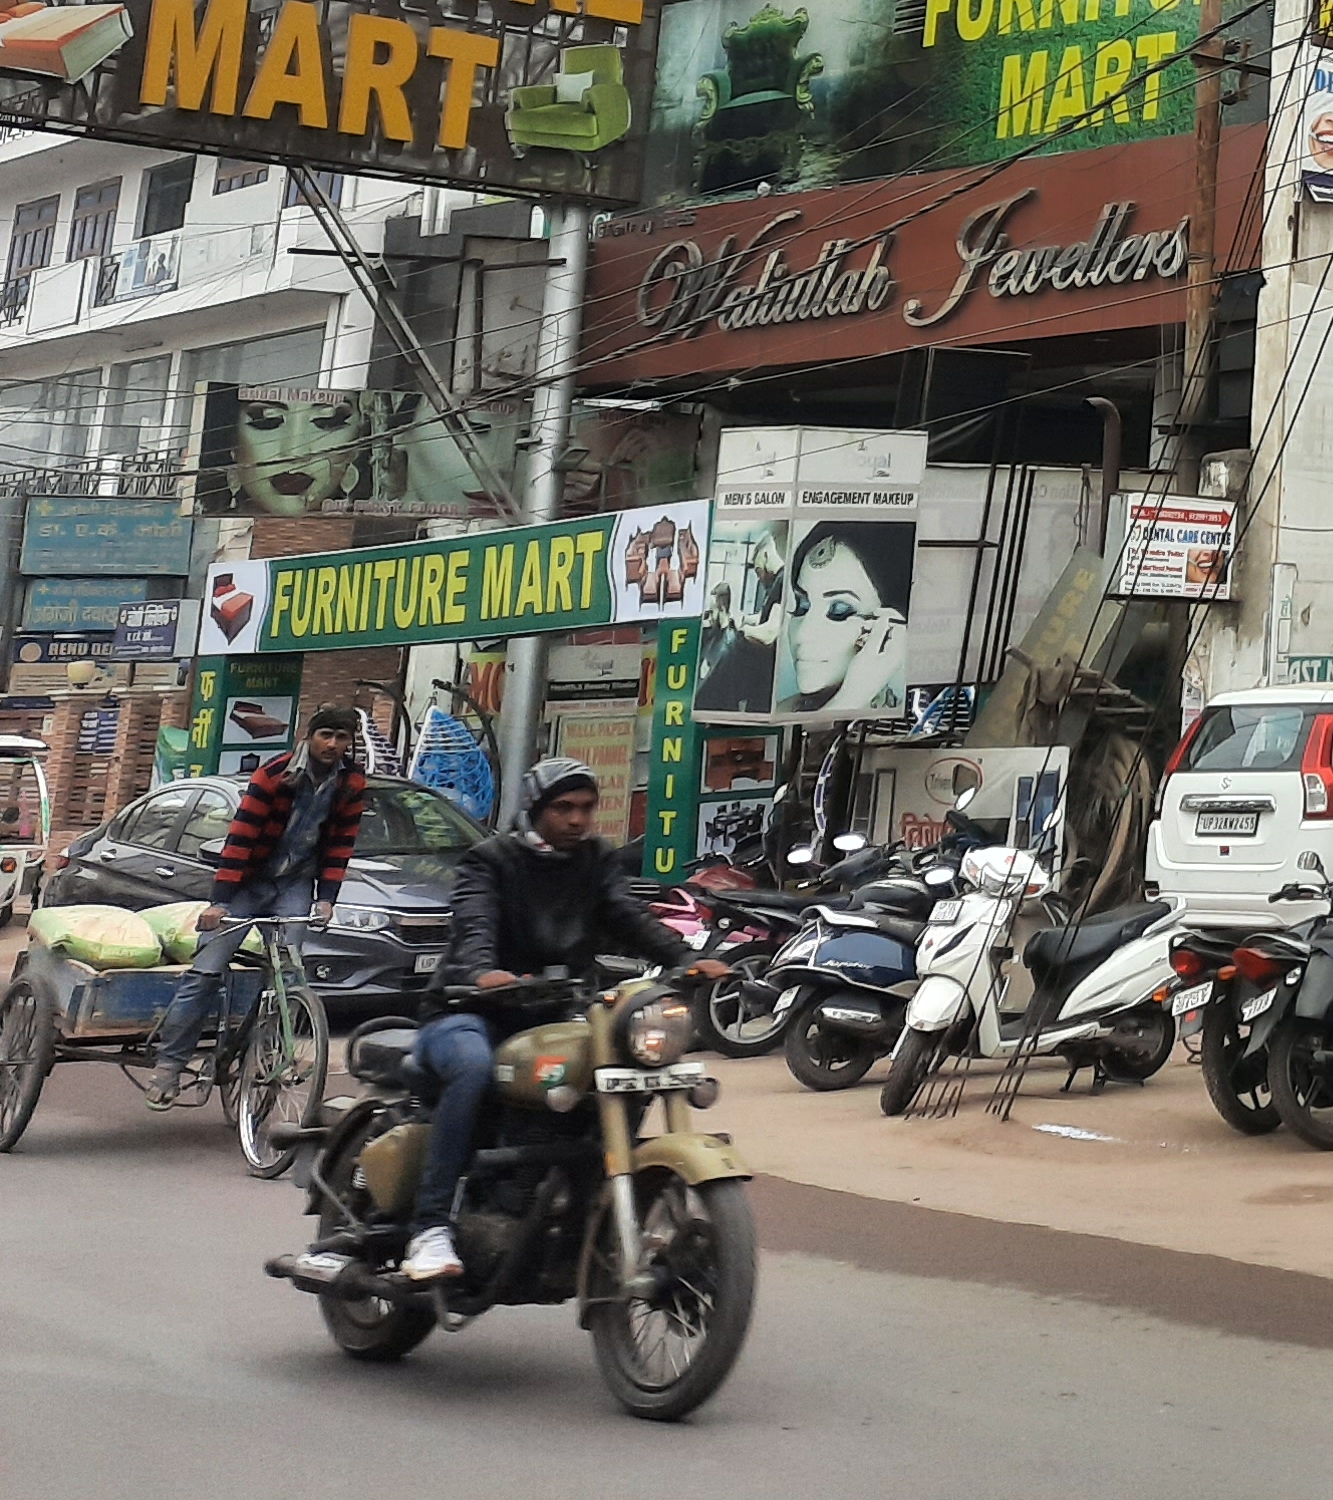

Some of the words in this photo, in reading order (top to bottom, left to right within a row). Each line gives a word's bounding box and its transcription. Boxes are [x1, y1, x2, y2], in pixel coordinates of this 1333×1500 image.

[996, 31, 1177, 139] MART
[904, 188, 1189, 329] Jewellers
[754, 491, 785, 505] SALON
[802, 491, 871, 505] ENGAGEMENT
[873, 492, 914, 506] MAKEUP
[1143, 527, 1175, 542] DENTAL
[1177, 529, 1198, 543] CARE
[1201, 531, 1231, 545] CENTRE
[270, 550, 470, 638] FURNITURE
[481, 531, 604, 620] MART
[655, 628, 689, 874] FURNITU
